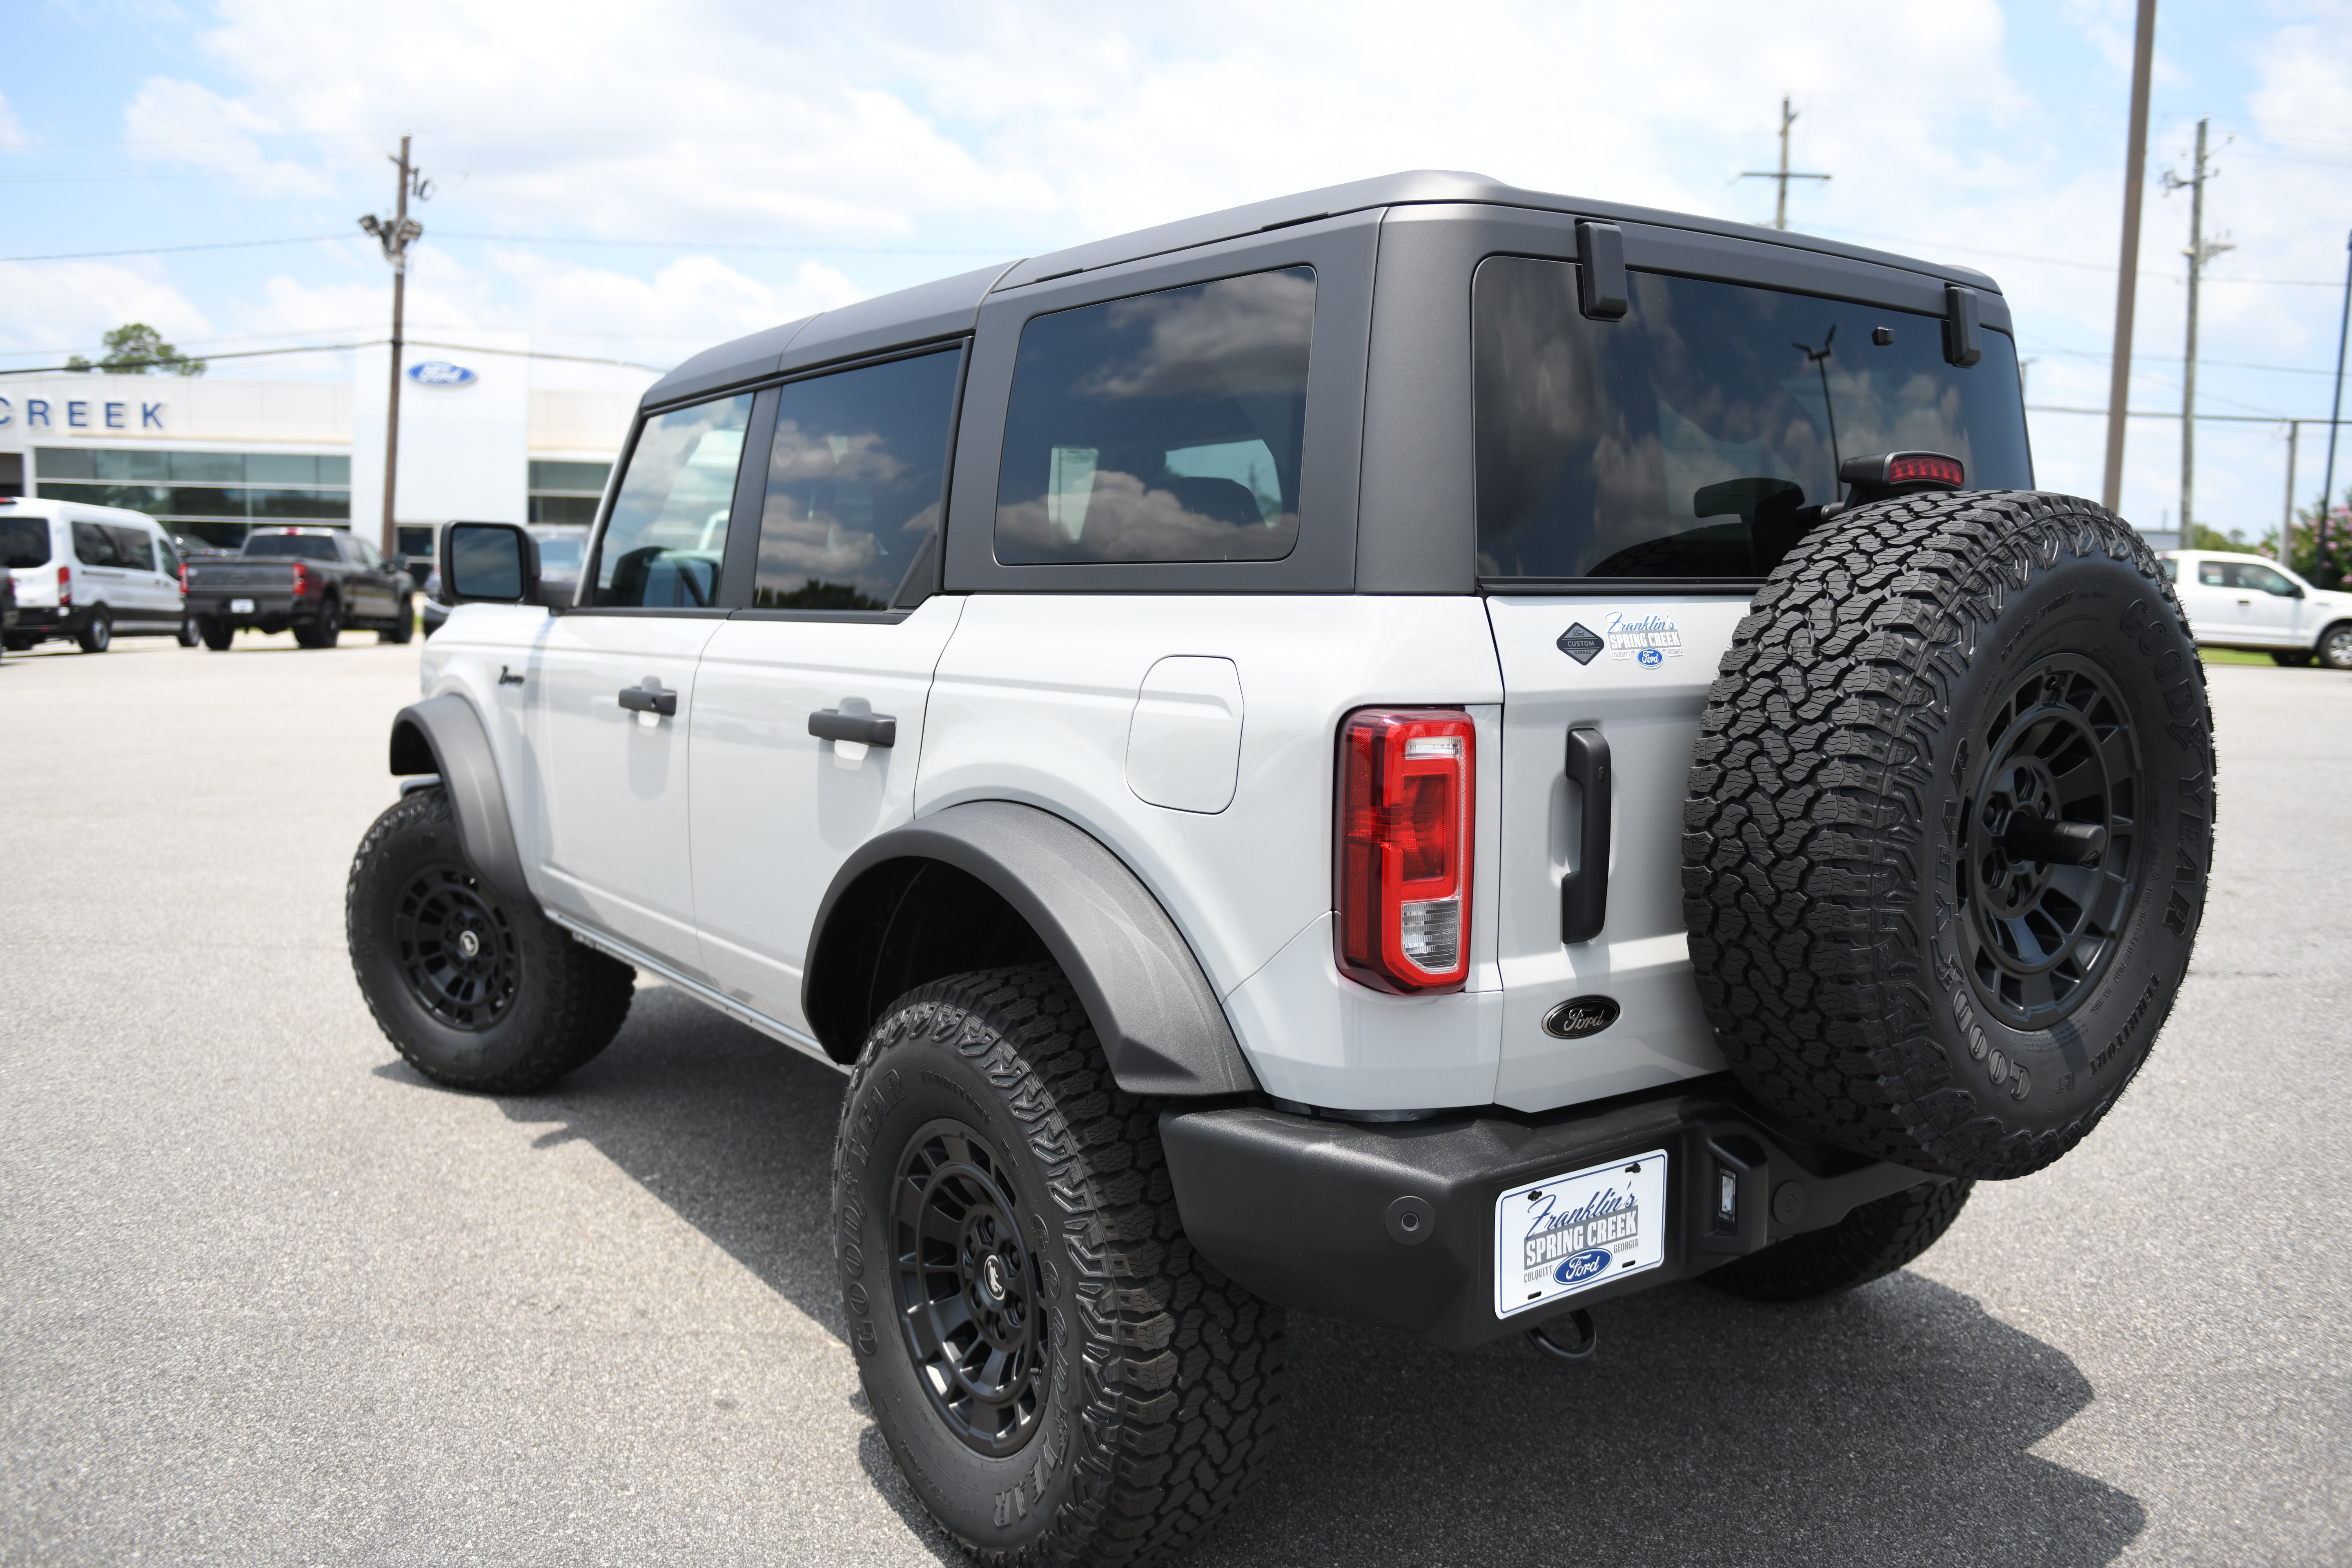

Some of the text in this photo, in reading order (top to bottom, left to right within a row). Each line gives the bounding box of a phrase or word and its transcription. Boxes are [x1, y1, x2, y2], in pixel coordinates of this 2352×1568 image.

[1605, 611, 1676, 634] Franklin's
[1609, 632, 1680, 649] SPRING CREEK
[1642, 650, 1659, 664] Ford
[1563, 1006, 1605, 1031] Ford
[2089, 972, 2160, 1078] TERRITORY
[918, 1070, 992, 1125] TERRITORY
[1525, 1180, 1638, 1240] Franklin's
[1526, 1210, 1637, 1266] SPRING CREEK
[1613, 1238, 1638, 1254] GEORGIA
[1524, 1265, 1553, 1283] COLQUITT
[1565, 1253, 1600, 1280] Ford
